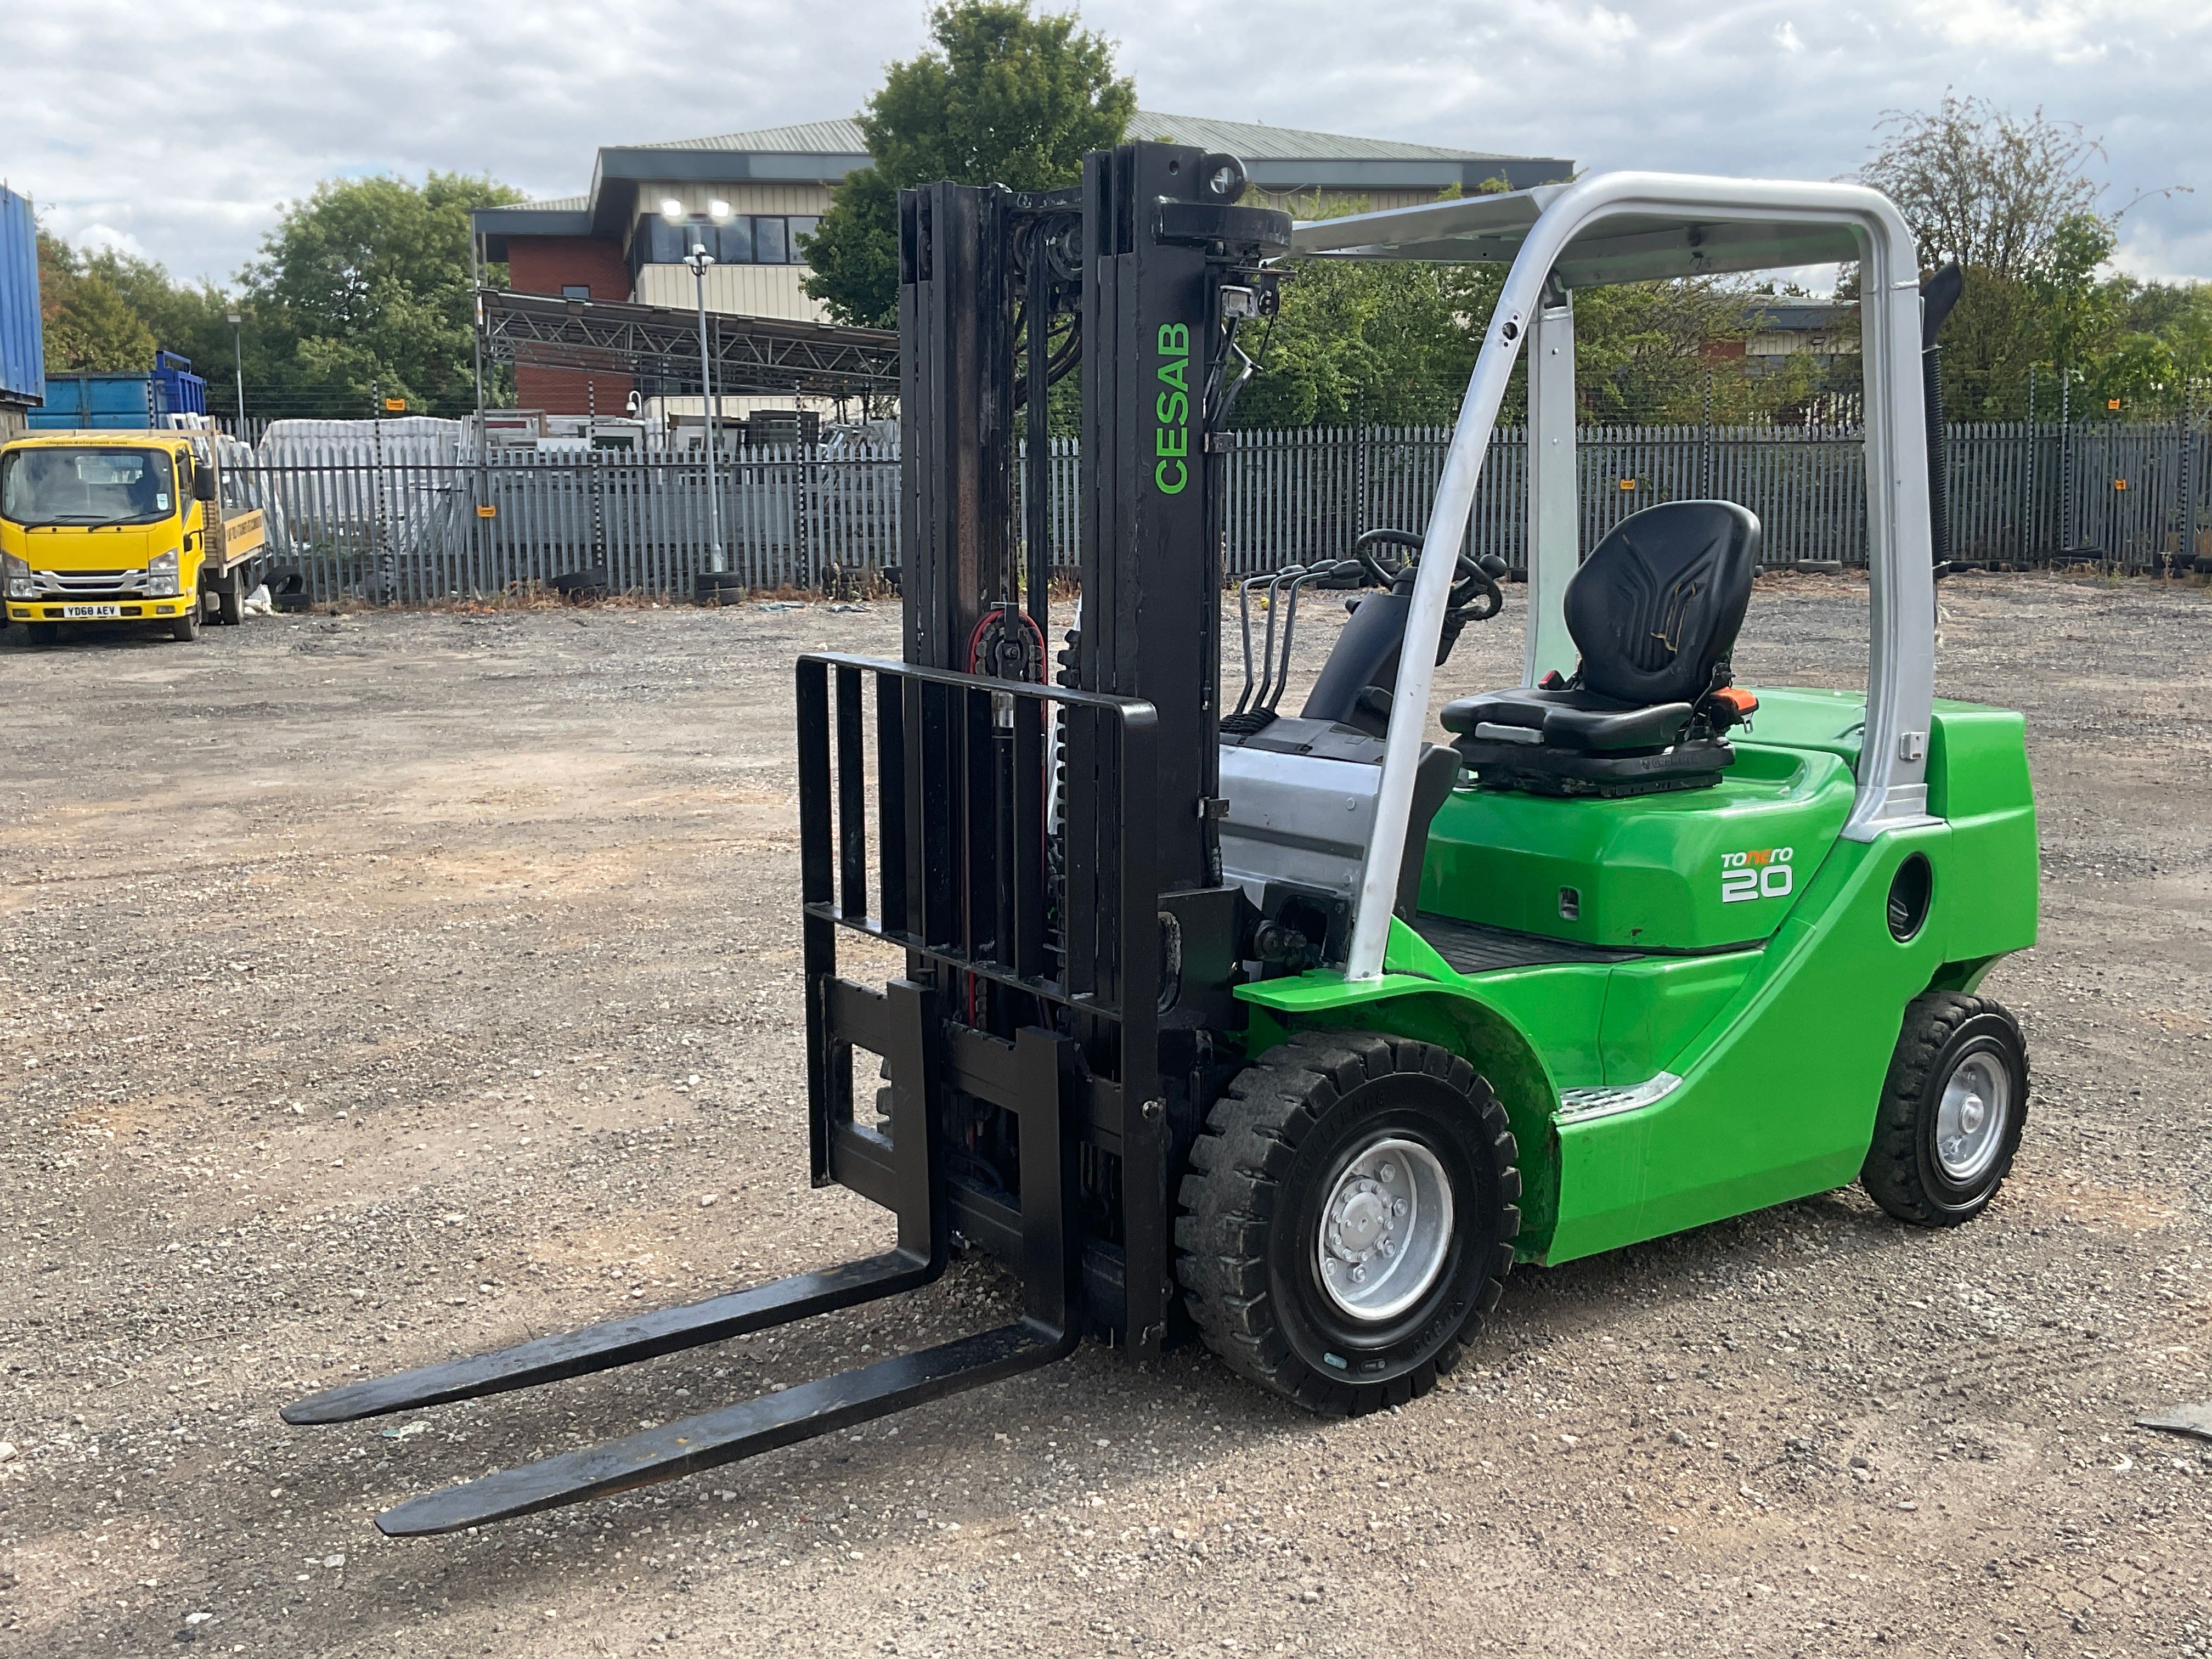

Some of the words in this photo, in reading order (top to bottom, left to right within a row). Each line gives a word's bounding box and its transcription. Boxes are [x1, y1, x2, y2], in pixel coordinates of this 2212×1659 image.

[1155, 322, 1189, 494] CESAB
[68, 607, 93, 616] YD68
[97, 606, 115, 615] AEV
[1722, 864, 1793, 902] 20
